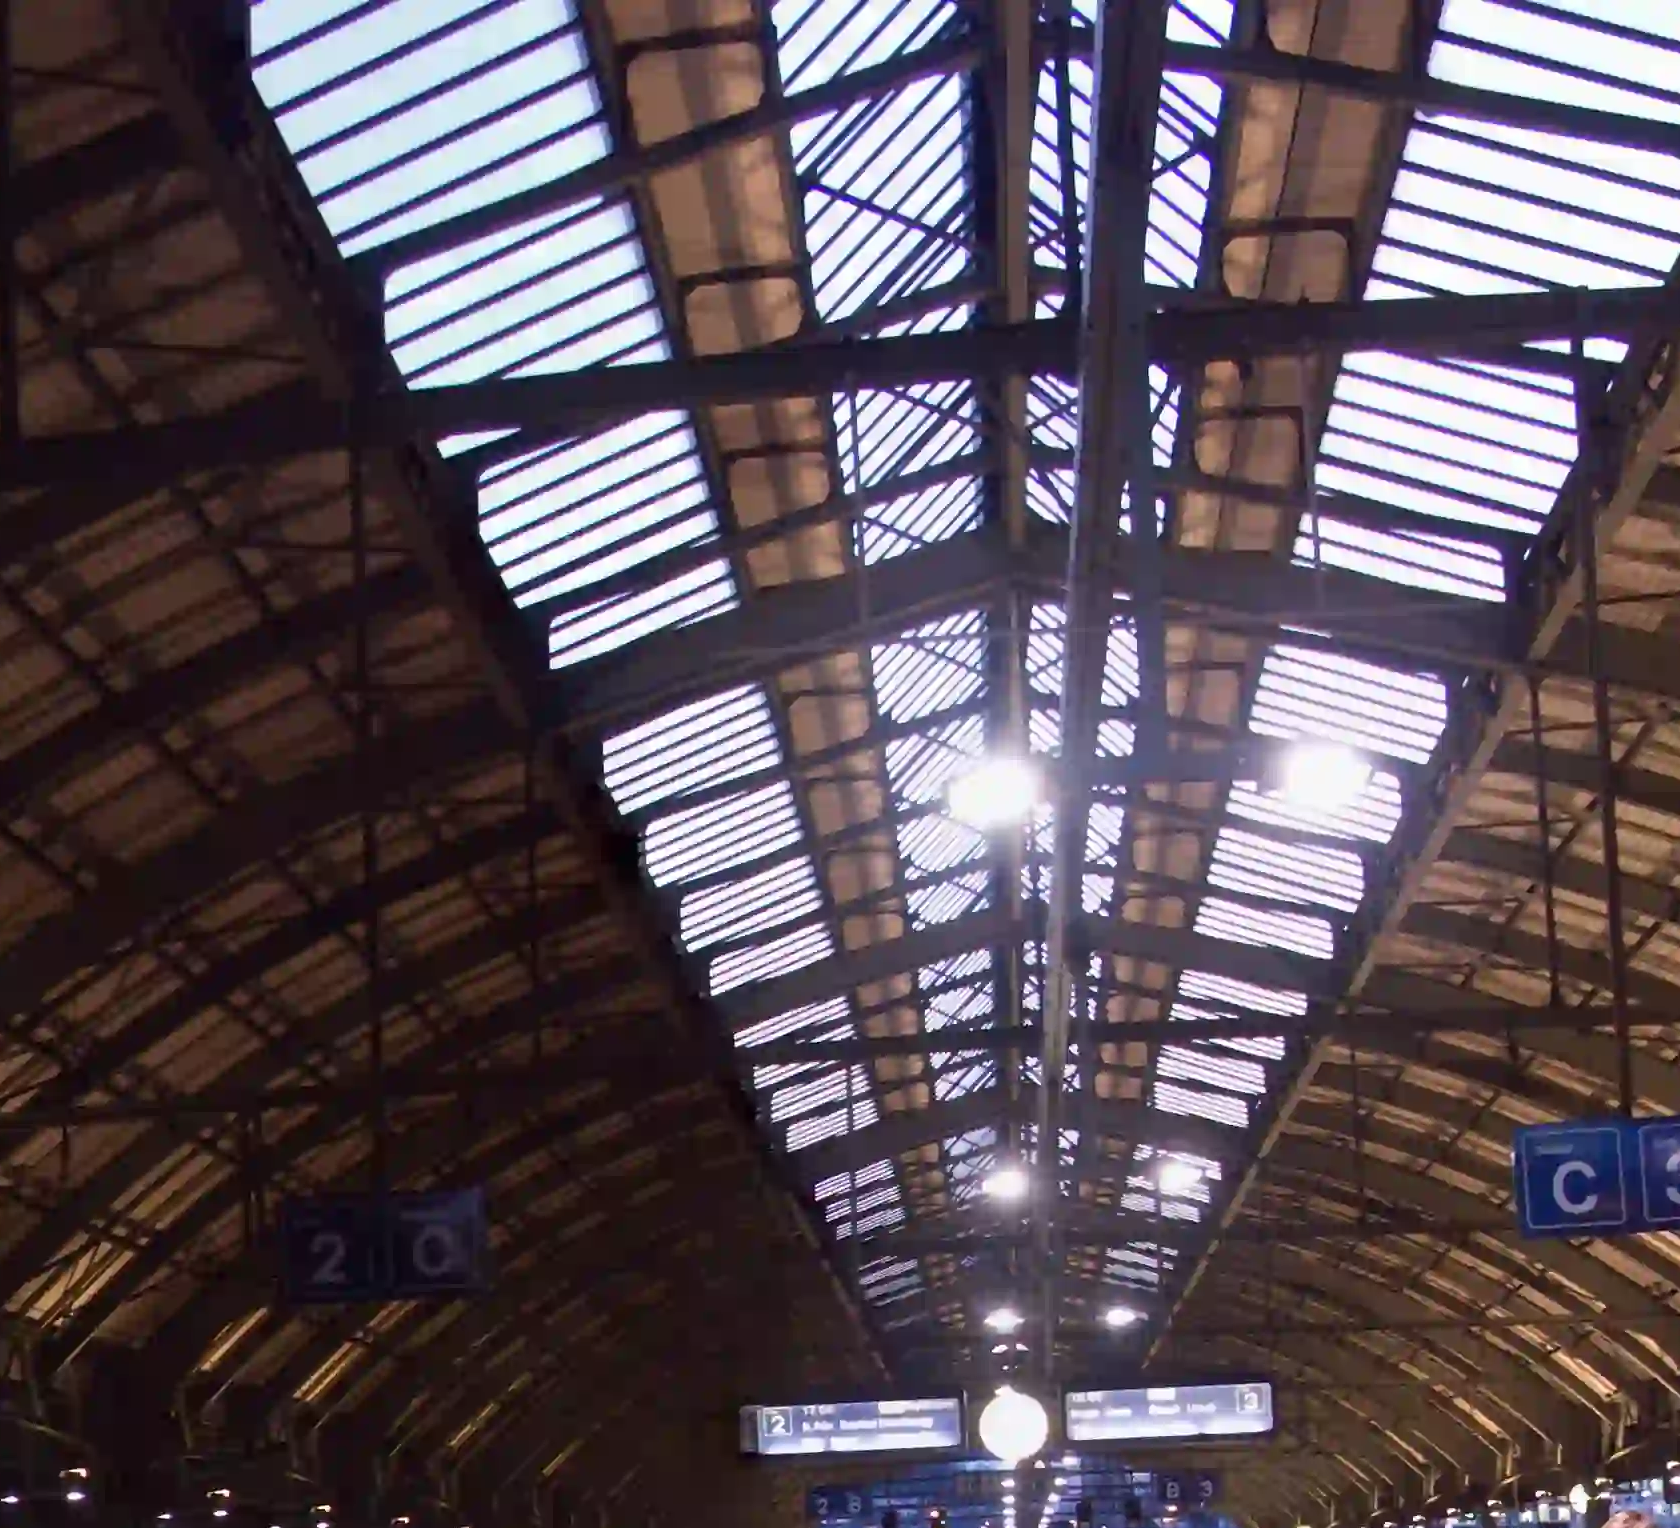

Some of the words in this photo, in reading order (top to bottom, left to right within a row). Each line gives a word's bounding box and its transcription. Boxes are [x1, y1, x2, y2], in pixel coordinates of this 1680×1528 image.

[1552, 1160, 1599, 1215] C
[309, 1232, 348, 1284] 2
[769, 1414, 787, 1434] 2
[1198, 1480, 1214, 1498] 3
[815, 1497, 829, 1515] 2
